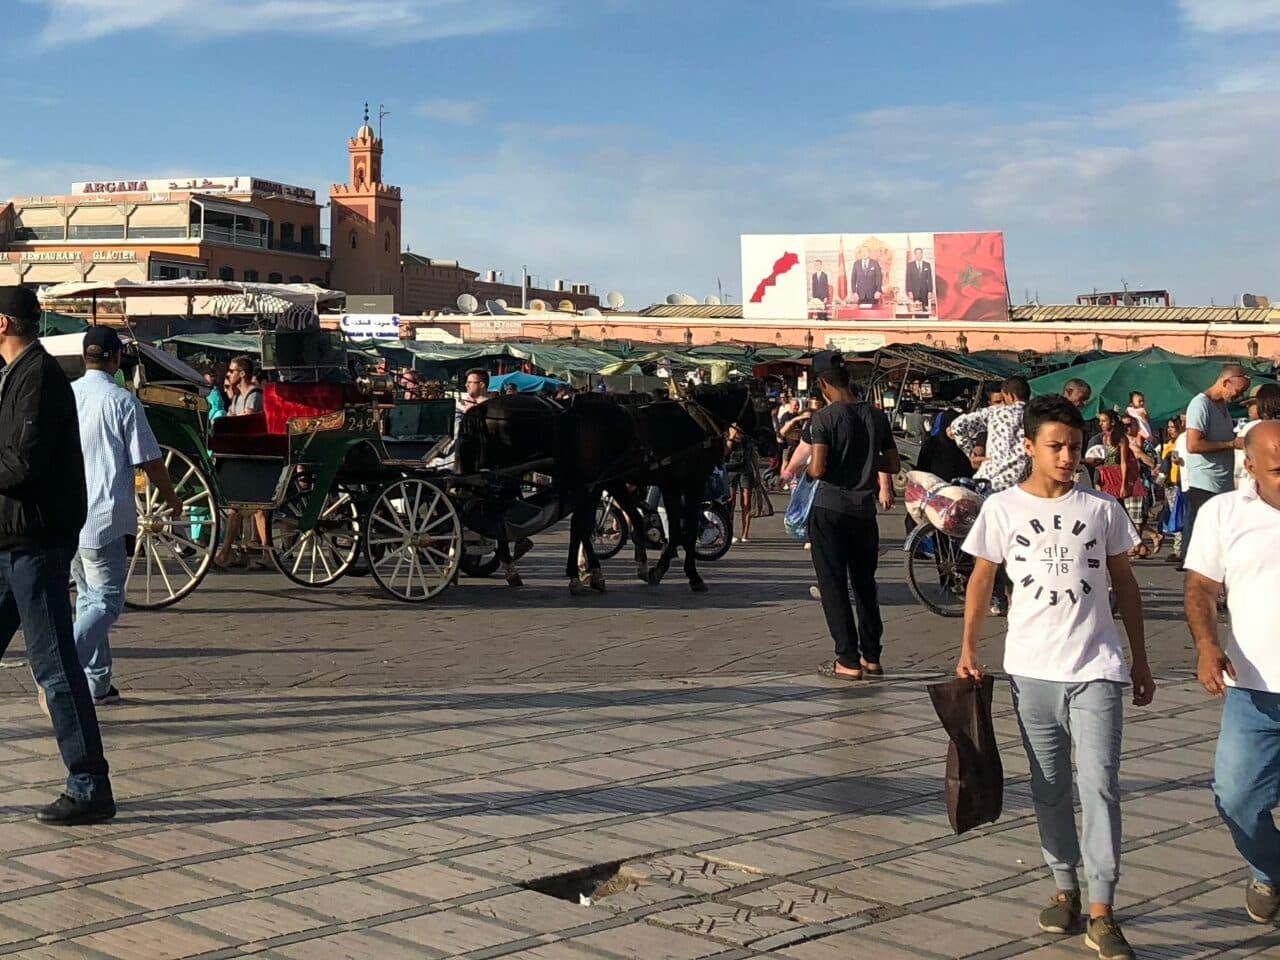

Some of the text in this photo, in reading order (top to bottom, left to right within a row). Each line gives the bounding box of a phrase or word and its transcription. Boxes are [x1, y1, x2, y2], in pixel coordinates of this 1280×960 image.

[83, 181, 149, 193] ARGANA
[21, 250, 83, 261] RESTAURANT
[92, 249, 137, 261] GLACIER
[348, 417, 374, 432] 249
[1015, 514, 1100, 569] FOREVER
[1020, 574, 1092, 607] PLEIN
